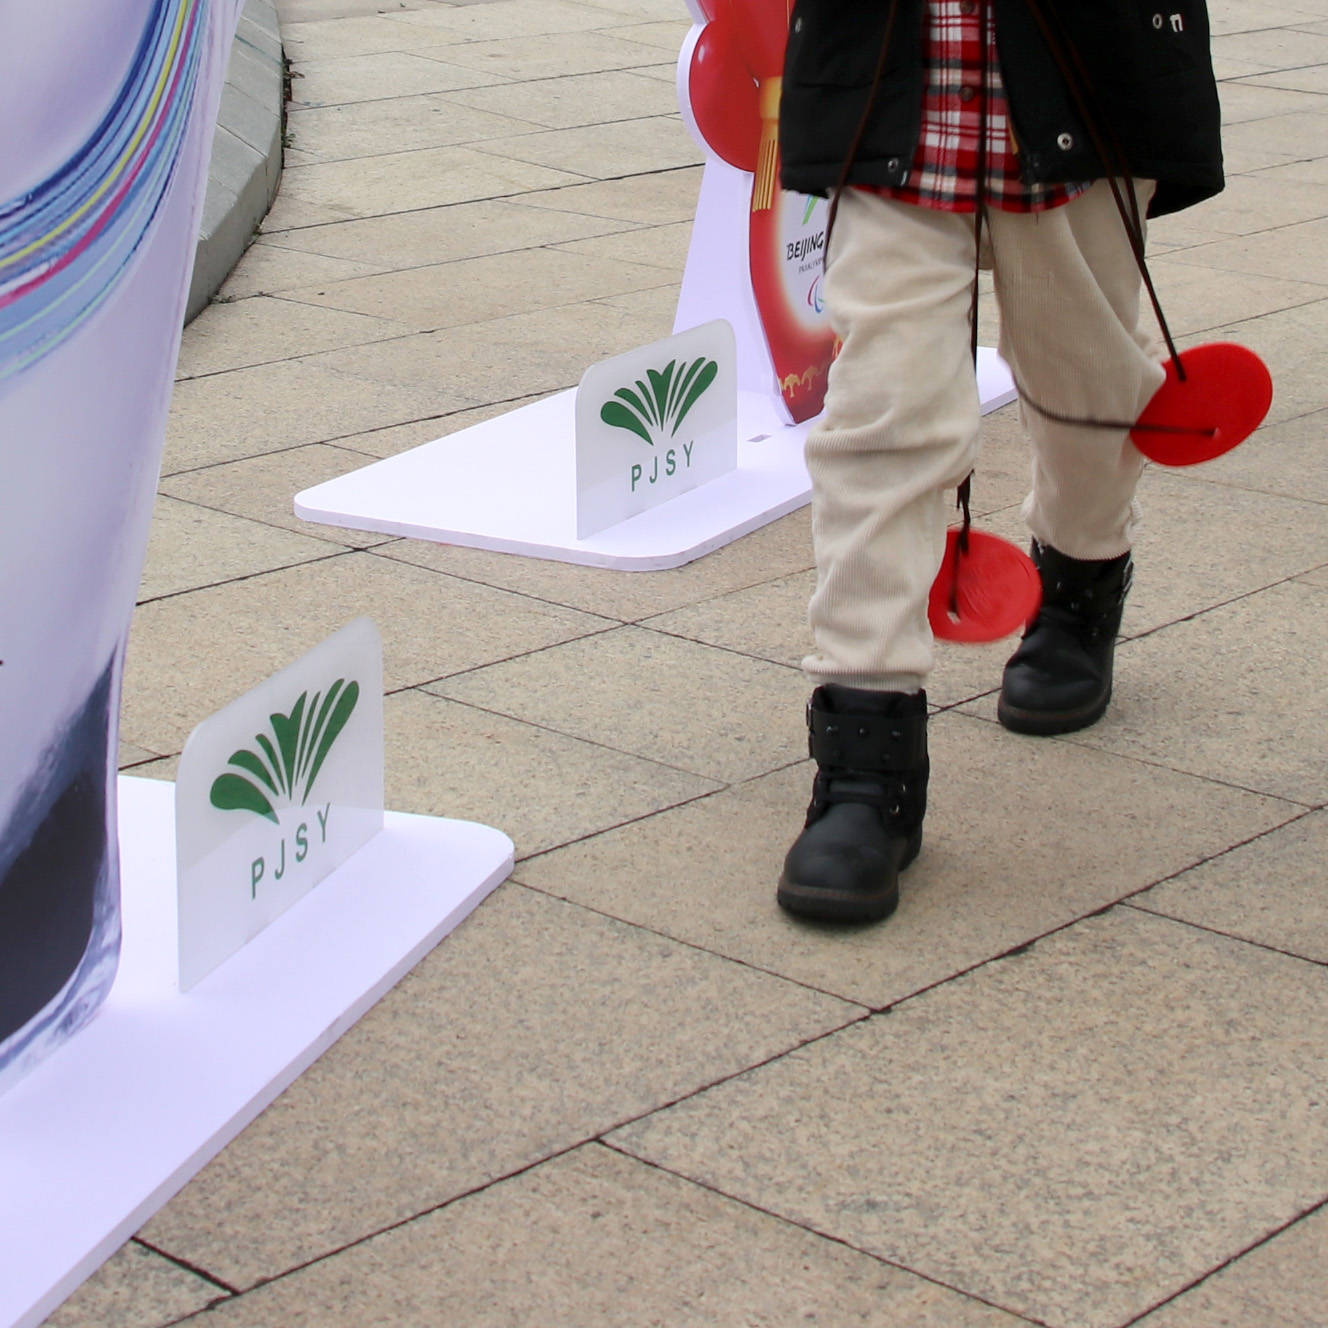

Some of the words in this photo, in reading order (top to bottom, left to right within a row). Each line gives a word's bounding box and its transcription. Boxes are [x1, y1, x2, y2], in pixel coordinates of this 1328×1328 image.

[786, 231, 824, 261] BEIJING
[631, 439, 694, 492] PJSY
[251, 802, 331, 900] PJSY
